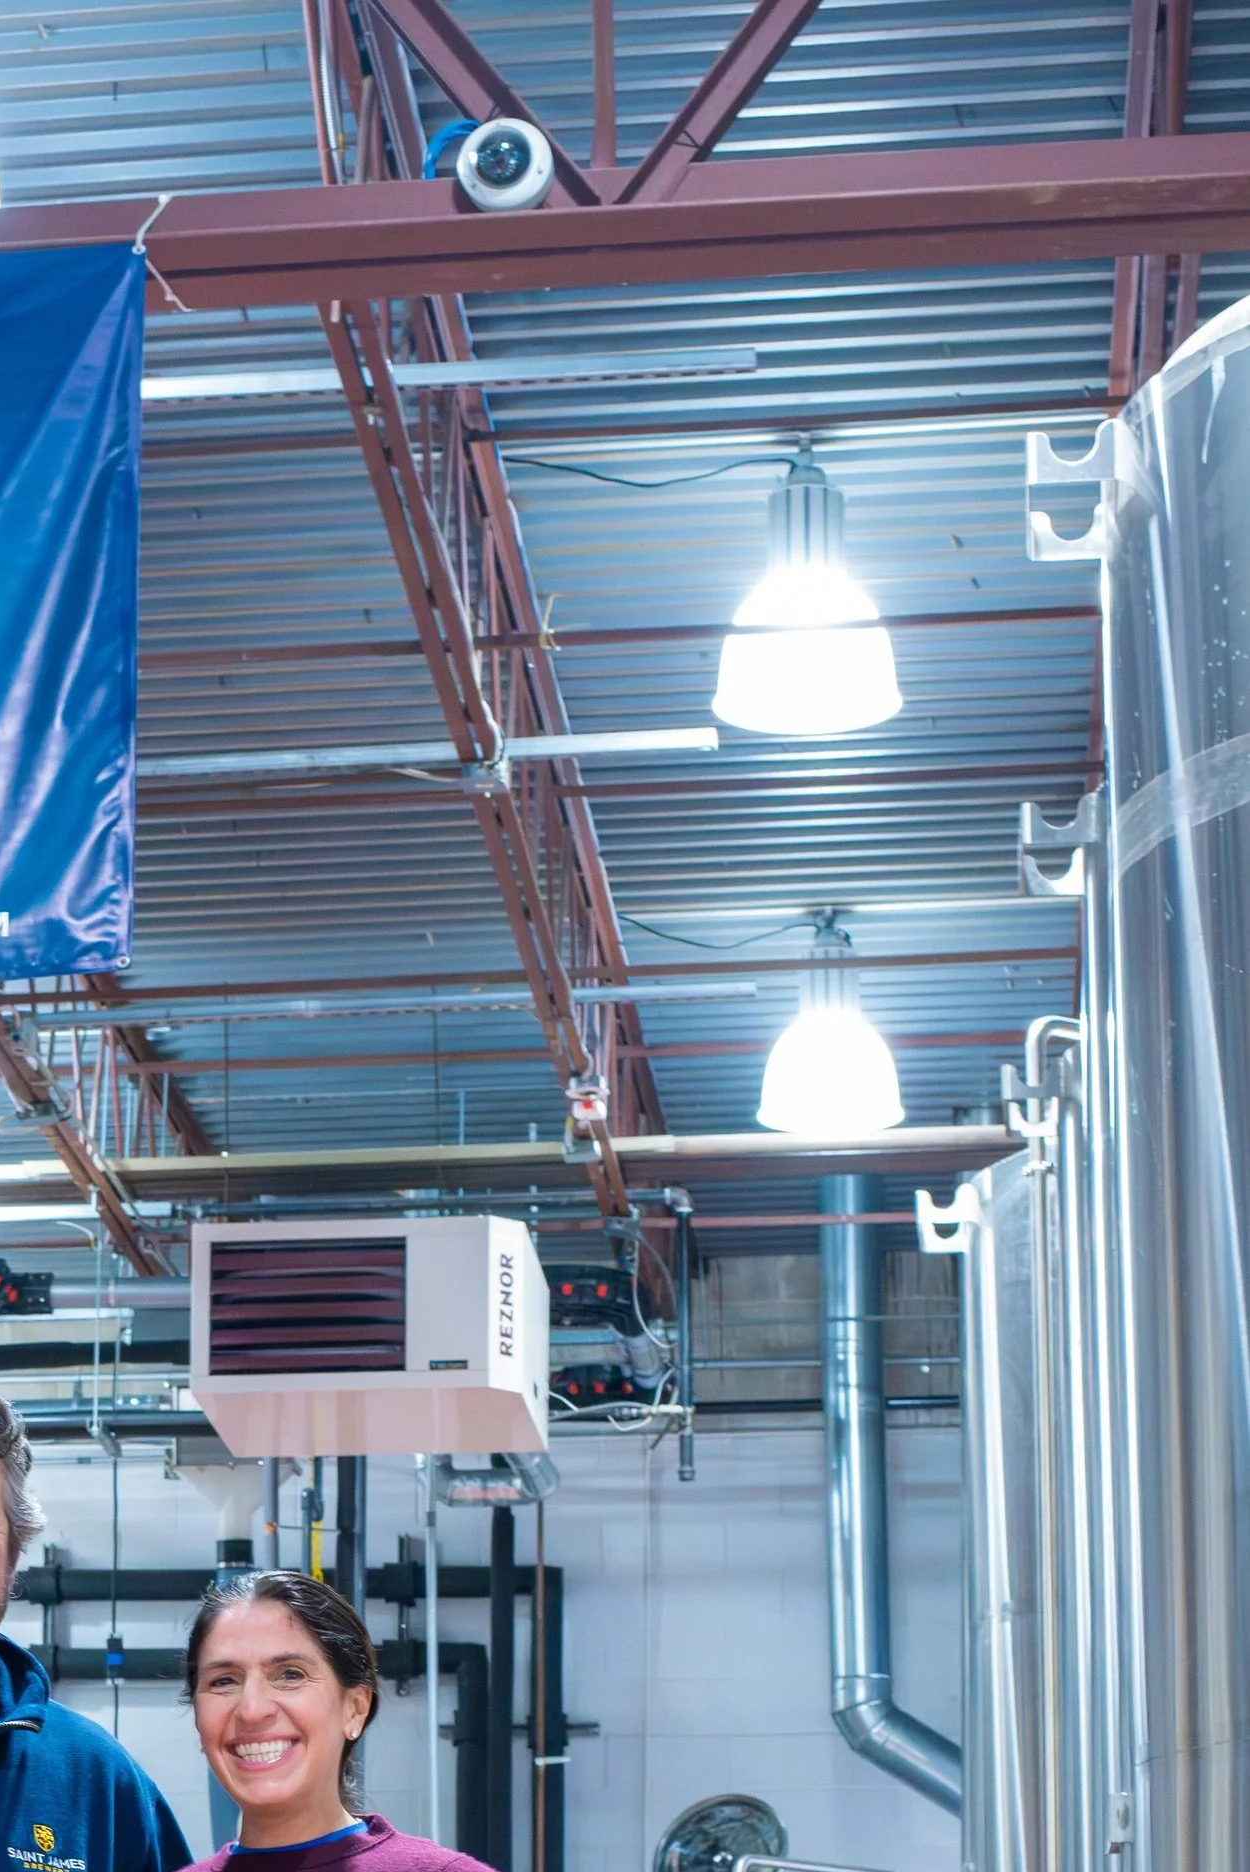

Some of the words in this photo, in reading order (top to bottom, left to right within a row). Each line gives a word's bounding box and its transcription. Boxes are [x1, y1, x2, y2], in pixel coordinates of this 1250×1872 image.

[500, 1253, 514, 1357] REZNOR
[7, 1847, 45, 1863] SAINT
[47, 1856, 85, 1870] JAMES
